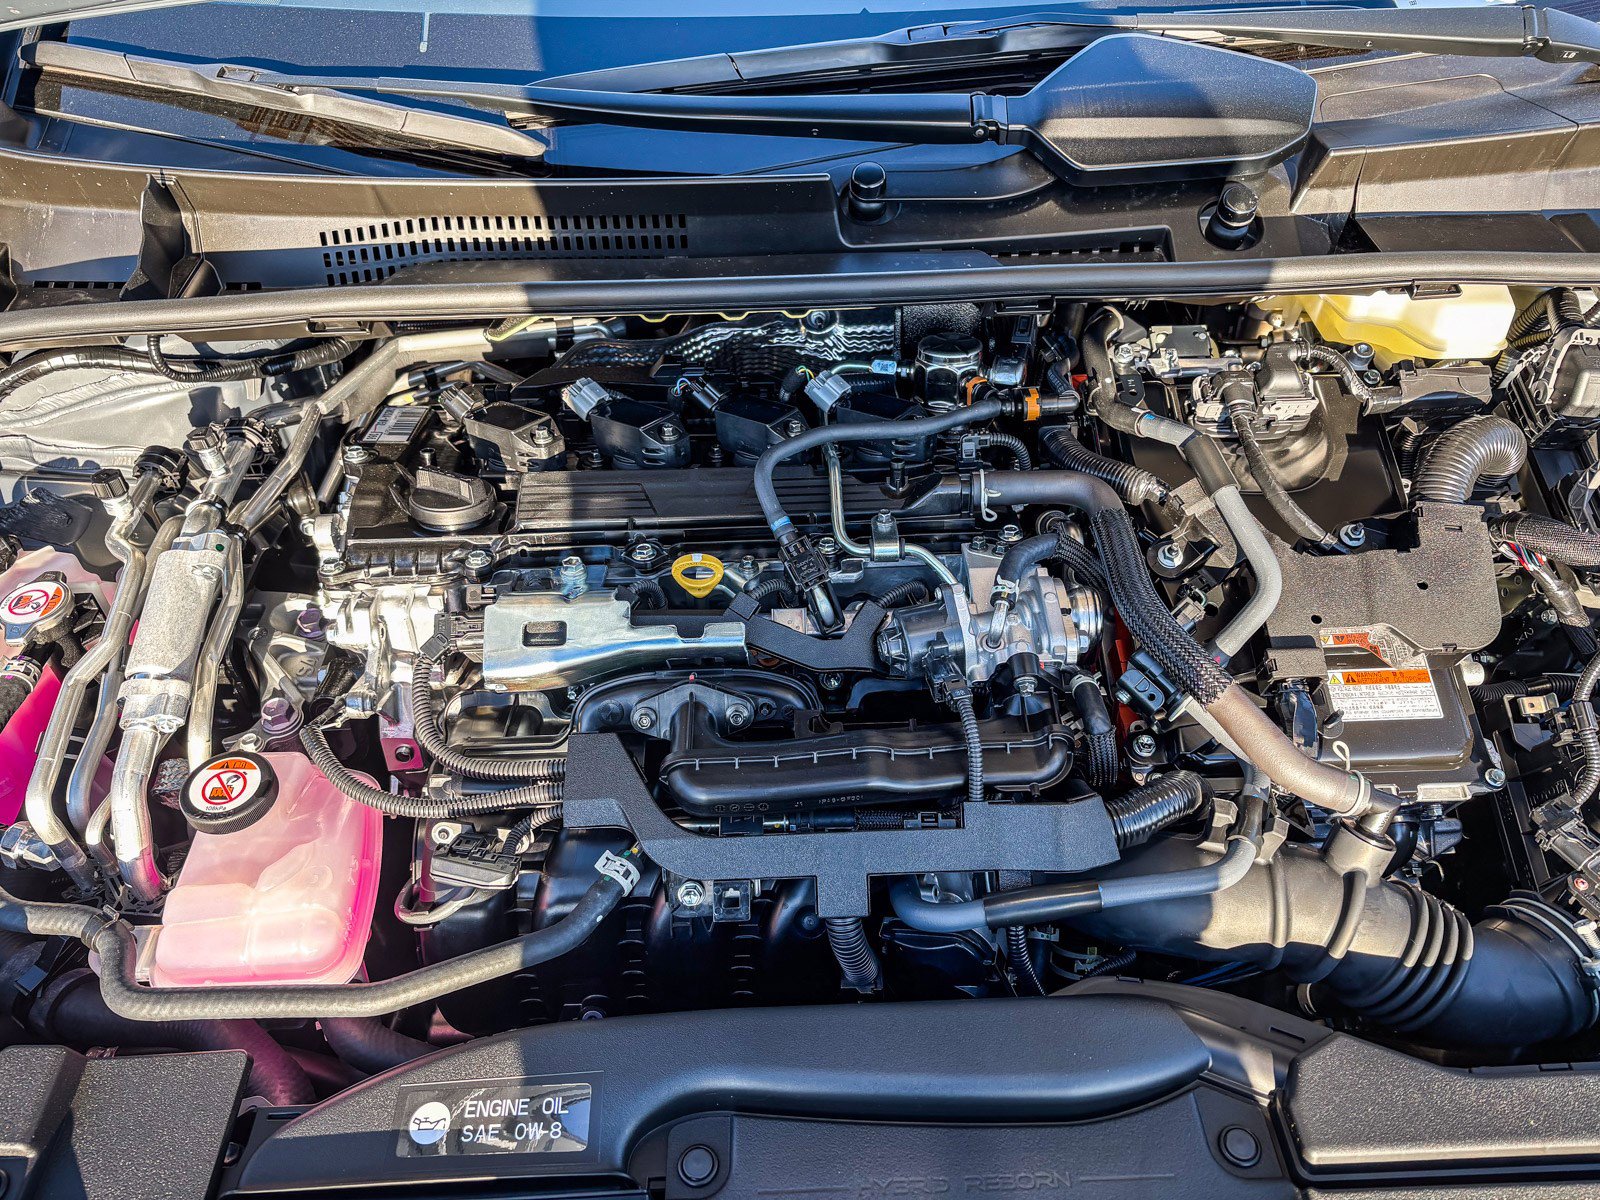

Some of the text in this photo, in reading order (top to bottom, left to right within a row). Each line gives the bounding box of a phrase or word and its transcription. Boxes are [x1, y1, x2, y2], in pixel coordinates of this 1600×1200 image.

[464, 1097, 569, 1118] ENGINE OIL
[461, 1121, 562, 1143] SAE 0W-8
